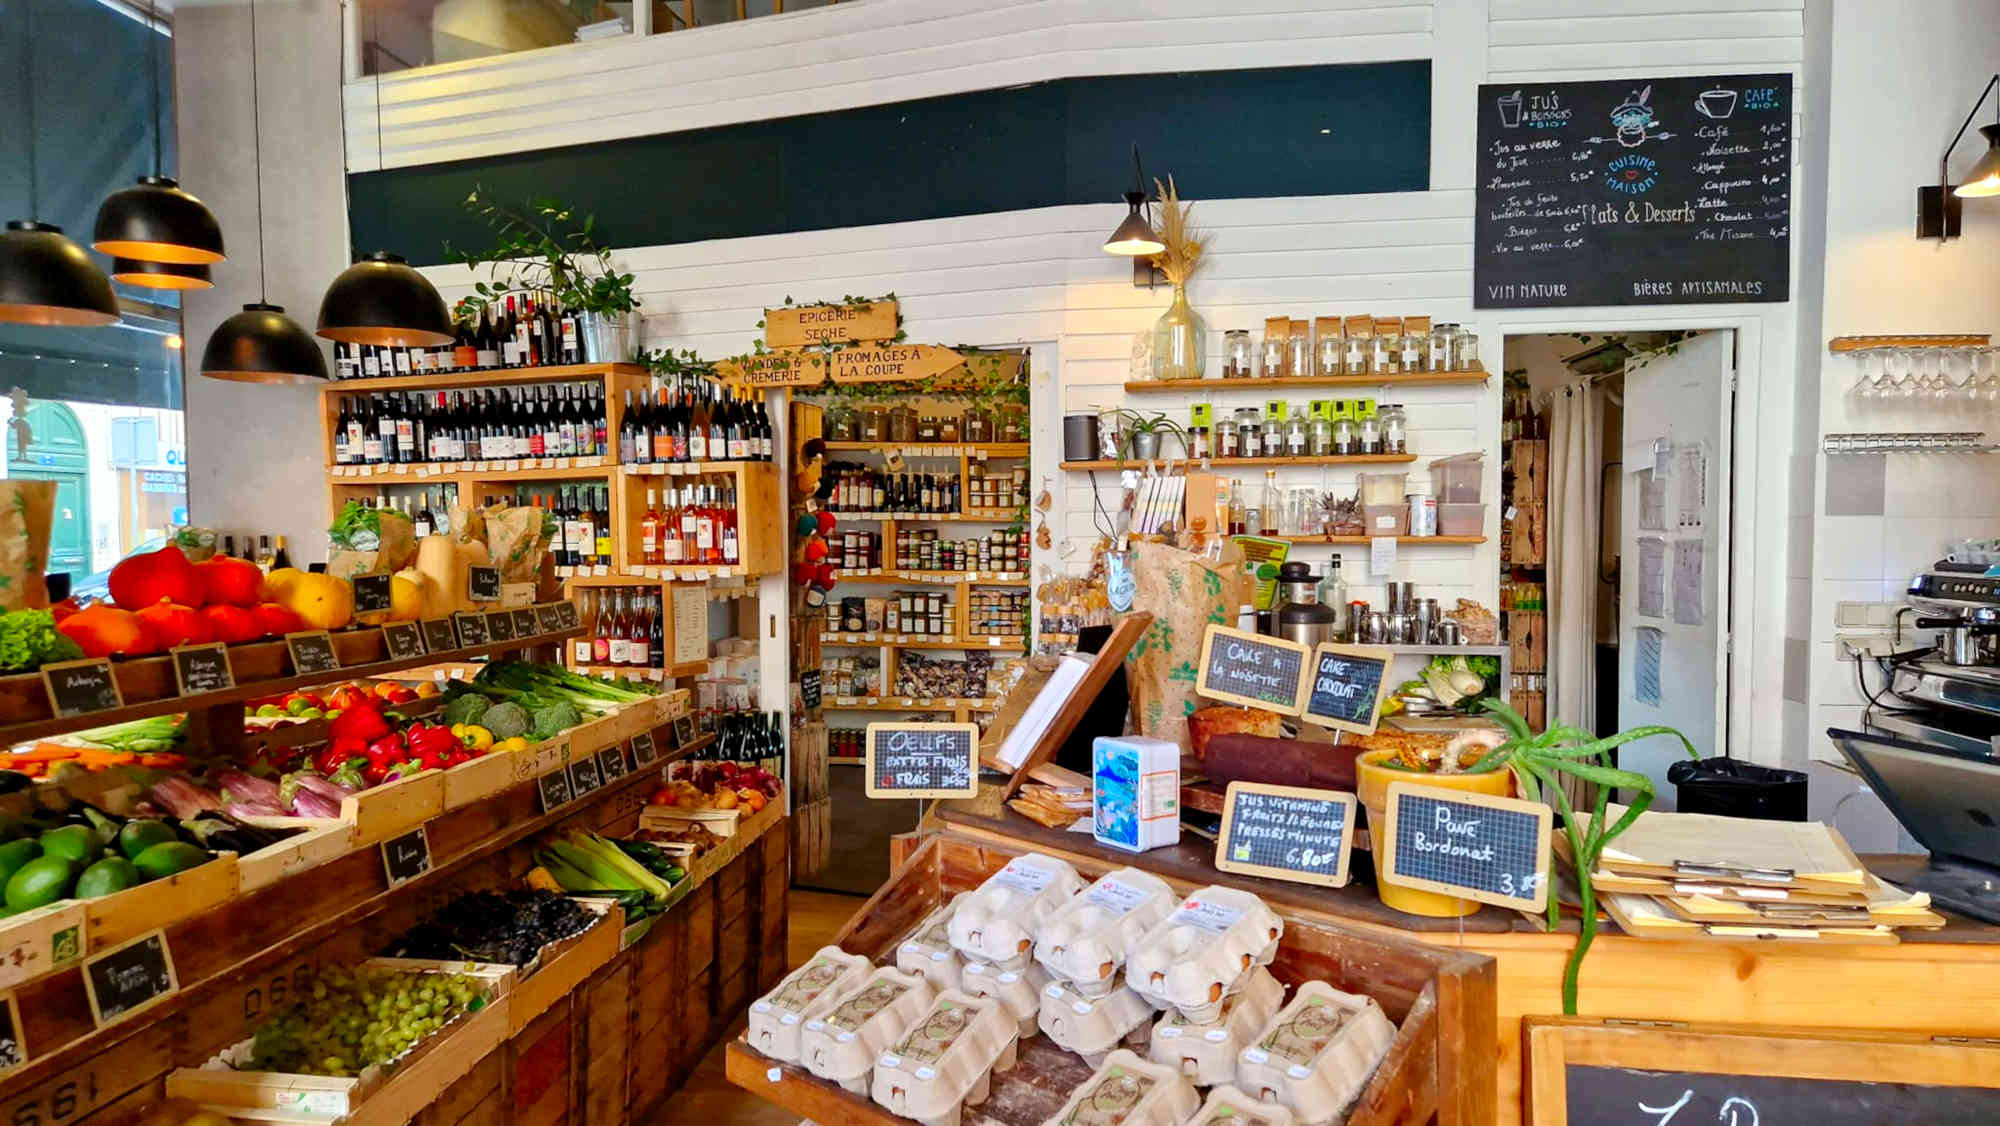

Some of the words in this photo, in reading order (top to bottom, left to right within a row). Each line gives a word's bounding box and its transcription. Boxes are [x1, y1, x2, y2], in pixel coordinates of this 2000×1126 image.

[1530, 94, 1560, 110] JUS
[1536, 121, 1560, 129] BIO
[1625, 200, 1640, 224] &
[1644, 200, 1697, 223] Desserts
[1488, 285, 1515, 300] VIN
[800, 309, 857, 324] EPICERIE
[804, 327, 848, 341] SECHE
[837, 349, 908, 364] FROMAGES
[743, 369, 801, 385] CREMERIE
[840, 365, 859, 378] LA
[865, 363, 905, 377] COUPE
[1238, 794, 1264, 808] JUS
[1435, 806, 1481, 837] Pavé
